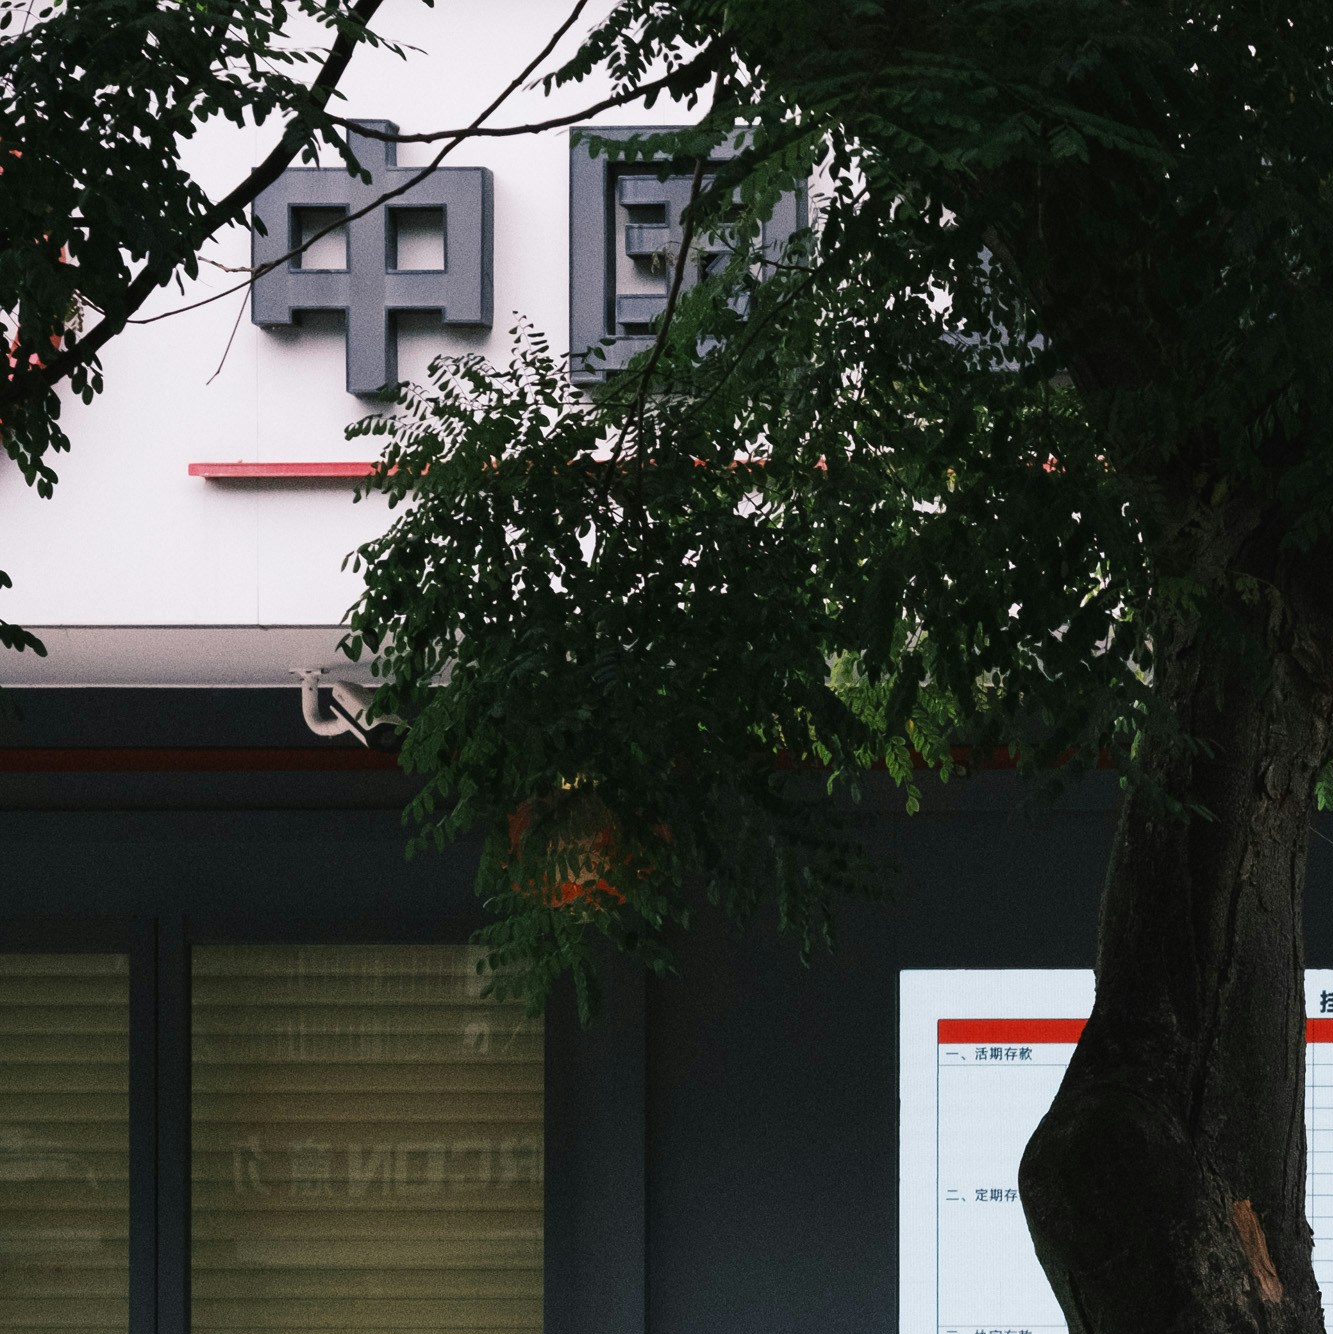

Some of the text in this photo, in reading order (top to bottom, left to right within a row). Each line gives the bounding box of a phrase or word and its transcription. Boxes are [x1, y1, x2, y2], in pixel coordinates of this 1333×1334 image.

[945, 1047, 1033, 1061] 一、活期存款
